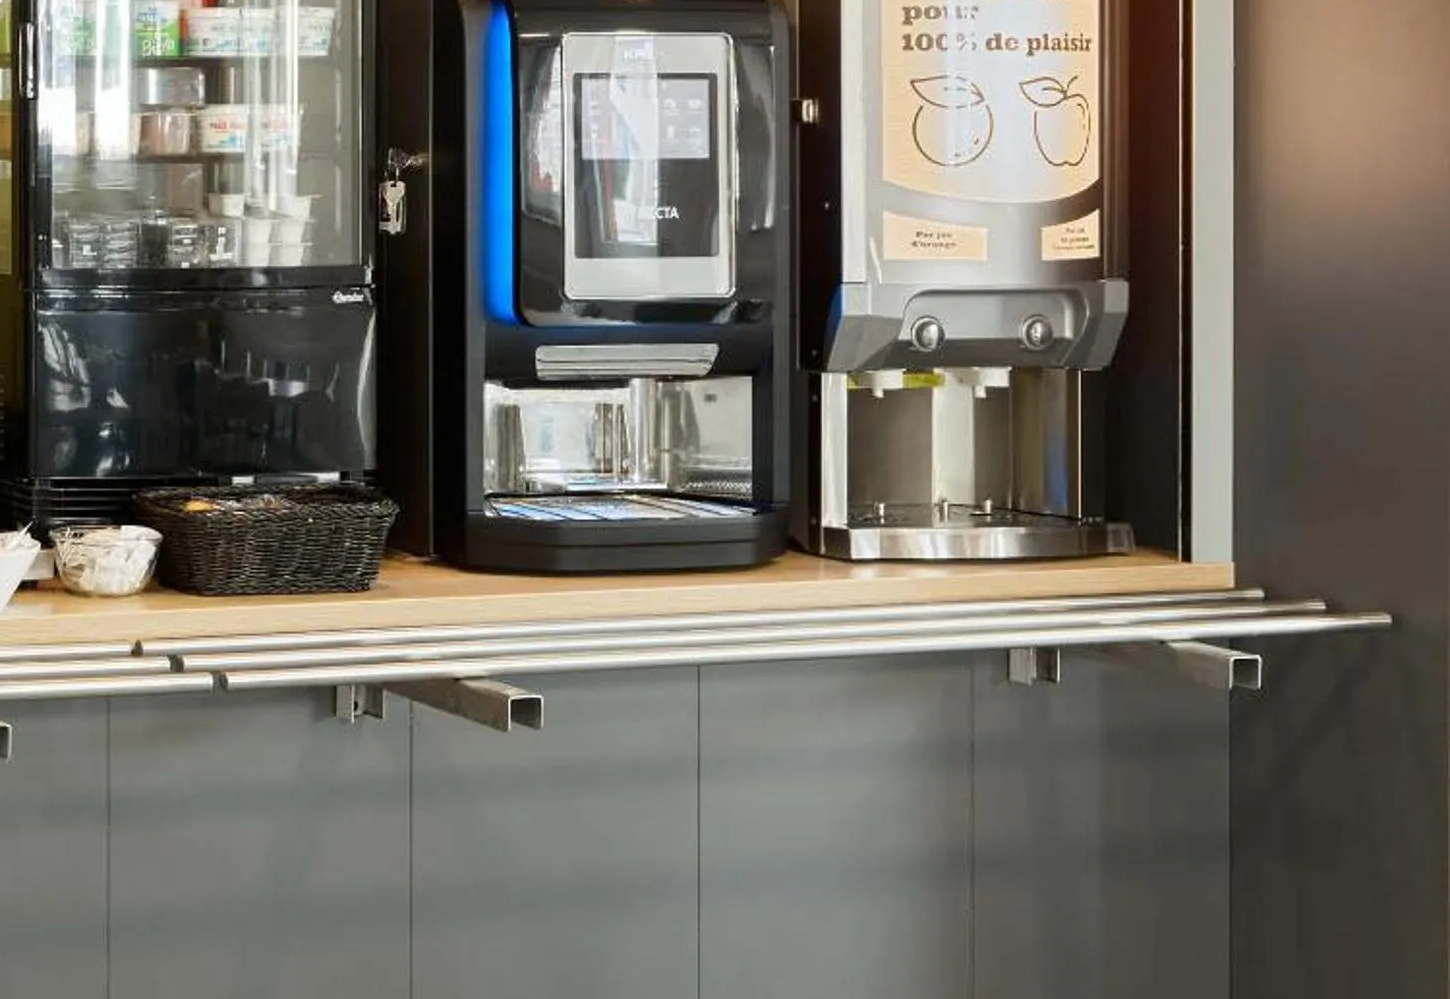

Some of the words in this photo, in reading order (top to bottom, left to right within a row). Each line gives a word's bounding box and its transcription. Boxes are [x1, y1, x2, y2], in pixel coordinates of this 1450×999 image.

[901, 33, 978, 51] 100%
[985, 33, 1019, 51] de
[1026, 33, 1093, 57] plaisir
